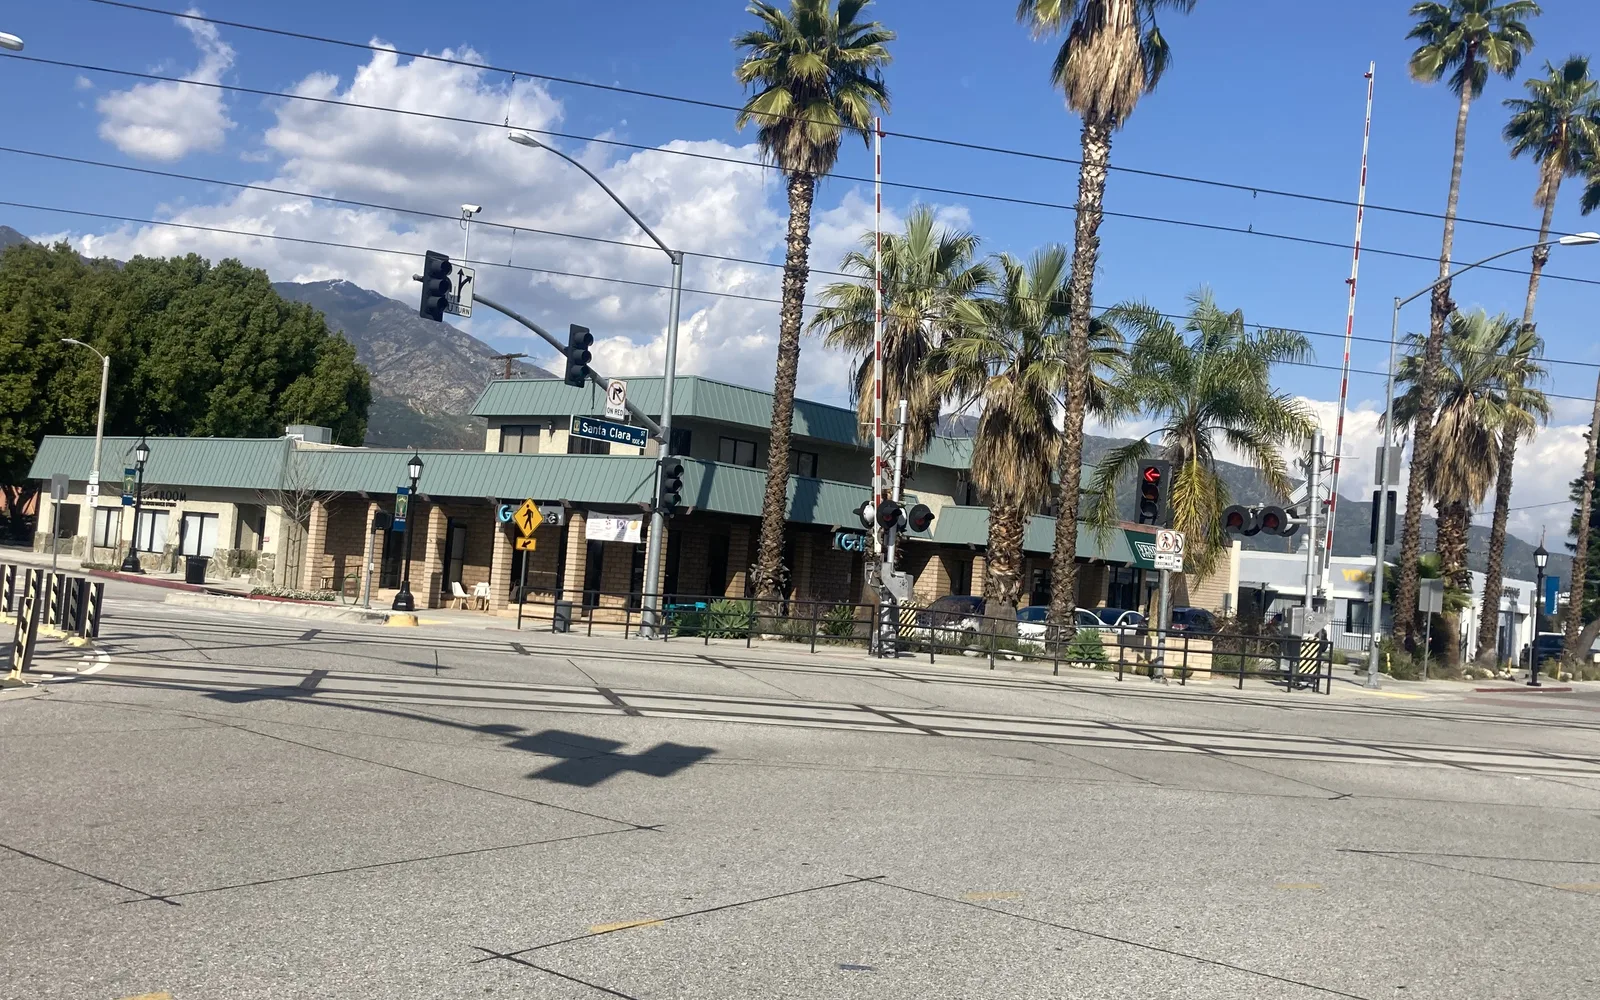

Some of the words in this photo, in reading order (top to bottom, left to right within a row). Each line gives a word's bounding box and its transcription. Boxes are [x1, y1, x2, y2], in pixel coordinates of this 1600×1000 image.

[614, 408, 624, 416] RED
[582, 422, 607, 436] Santa
[609, 427, 631, 440] Clara
